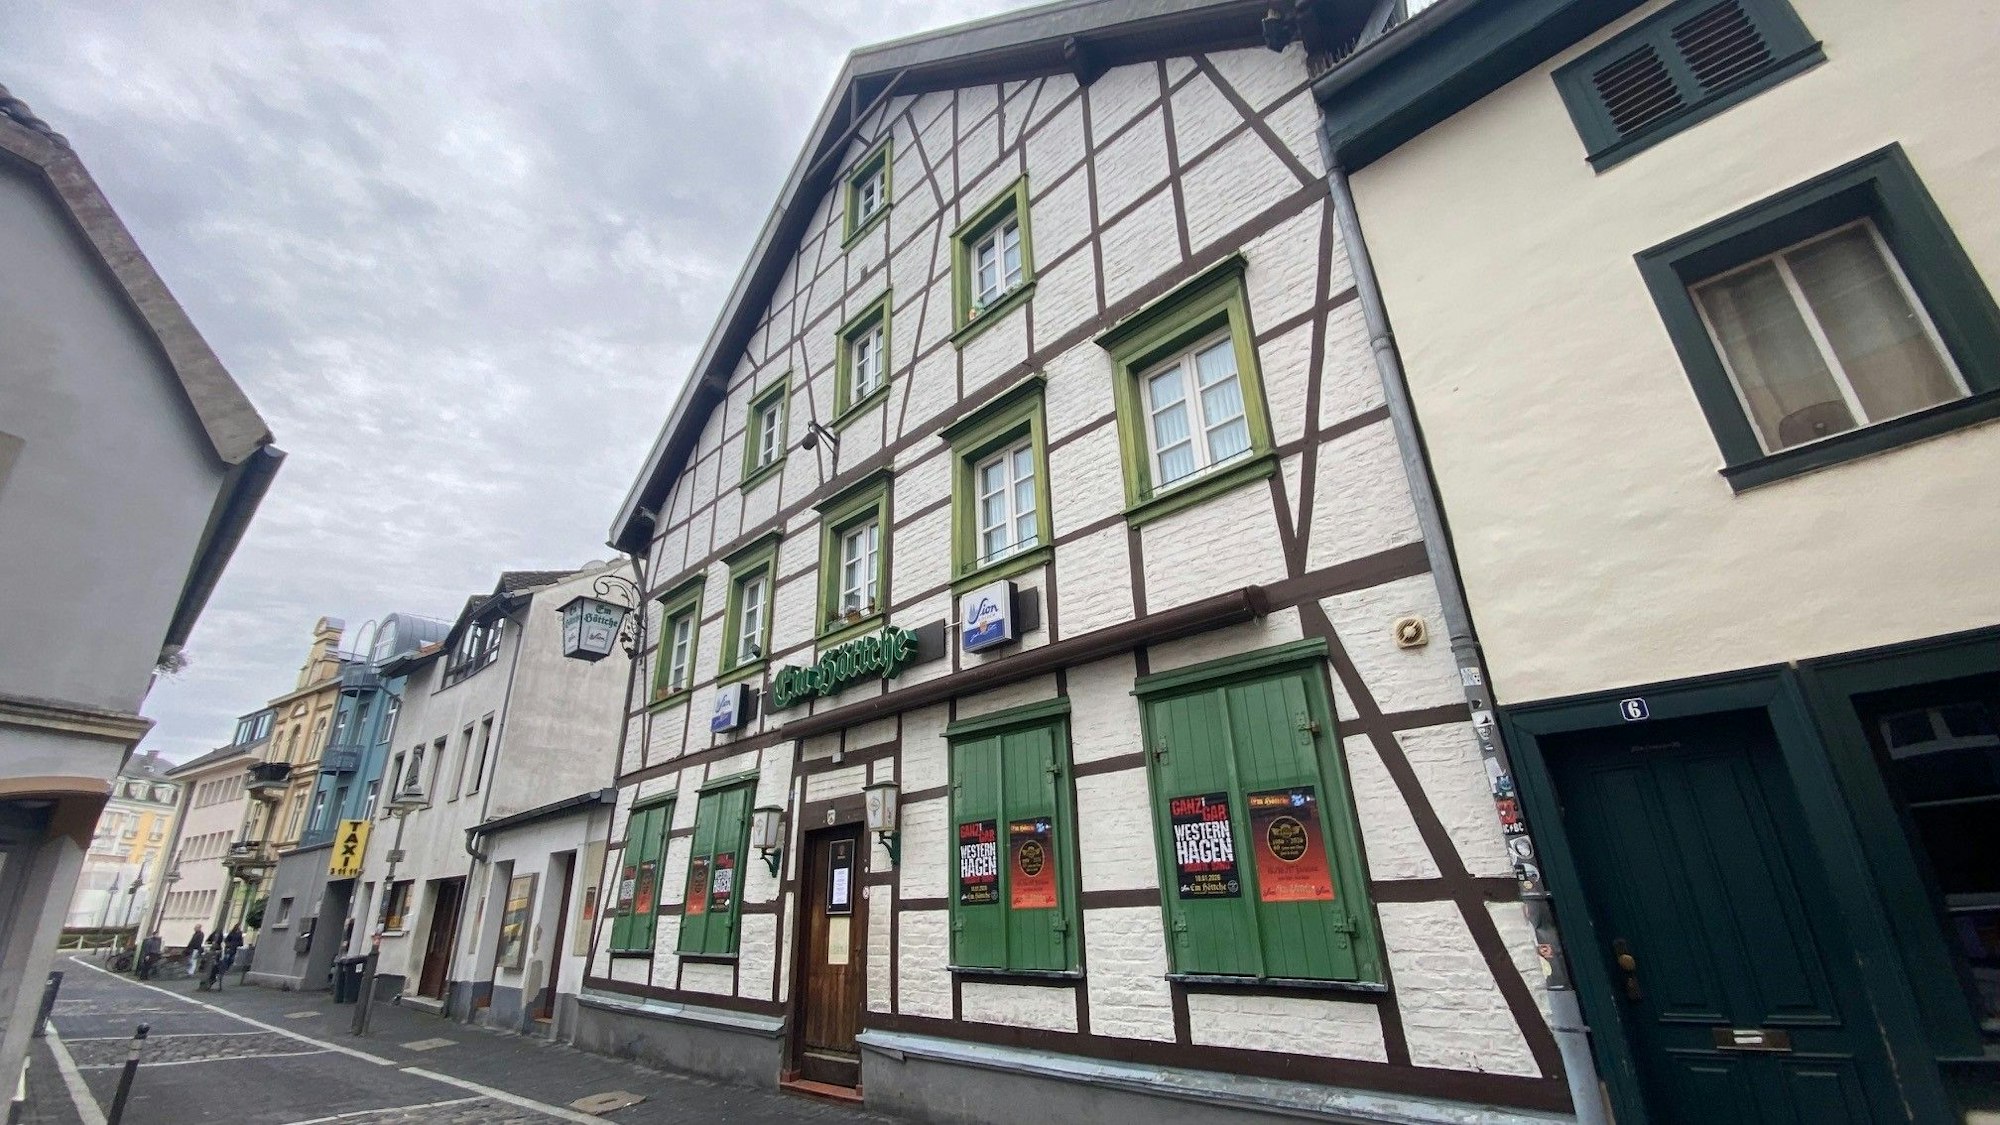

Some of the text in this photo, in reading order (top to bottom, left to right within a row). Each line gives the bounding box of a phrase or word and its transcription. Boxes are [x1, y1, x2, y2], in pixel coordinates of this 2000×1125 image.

[968, 597, 999, 625] Sion
[773, 665, 818, 708] Em
[1627, 700, 1642, 718] 6
[1171, 797, 1202, 816] GANZ
[1202, 803, 1228, 822] GAR
[1174, 820, 1231, 842] WESTERN
[342, 822, 363, 867] TAXI
[960, 842, 996, 859] WESTERN
[1176, 839, 1234, 865] HAGEN
[961, 857, 997, 878] HAGEN
